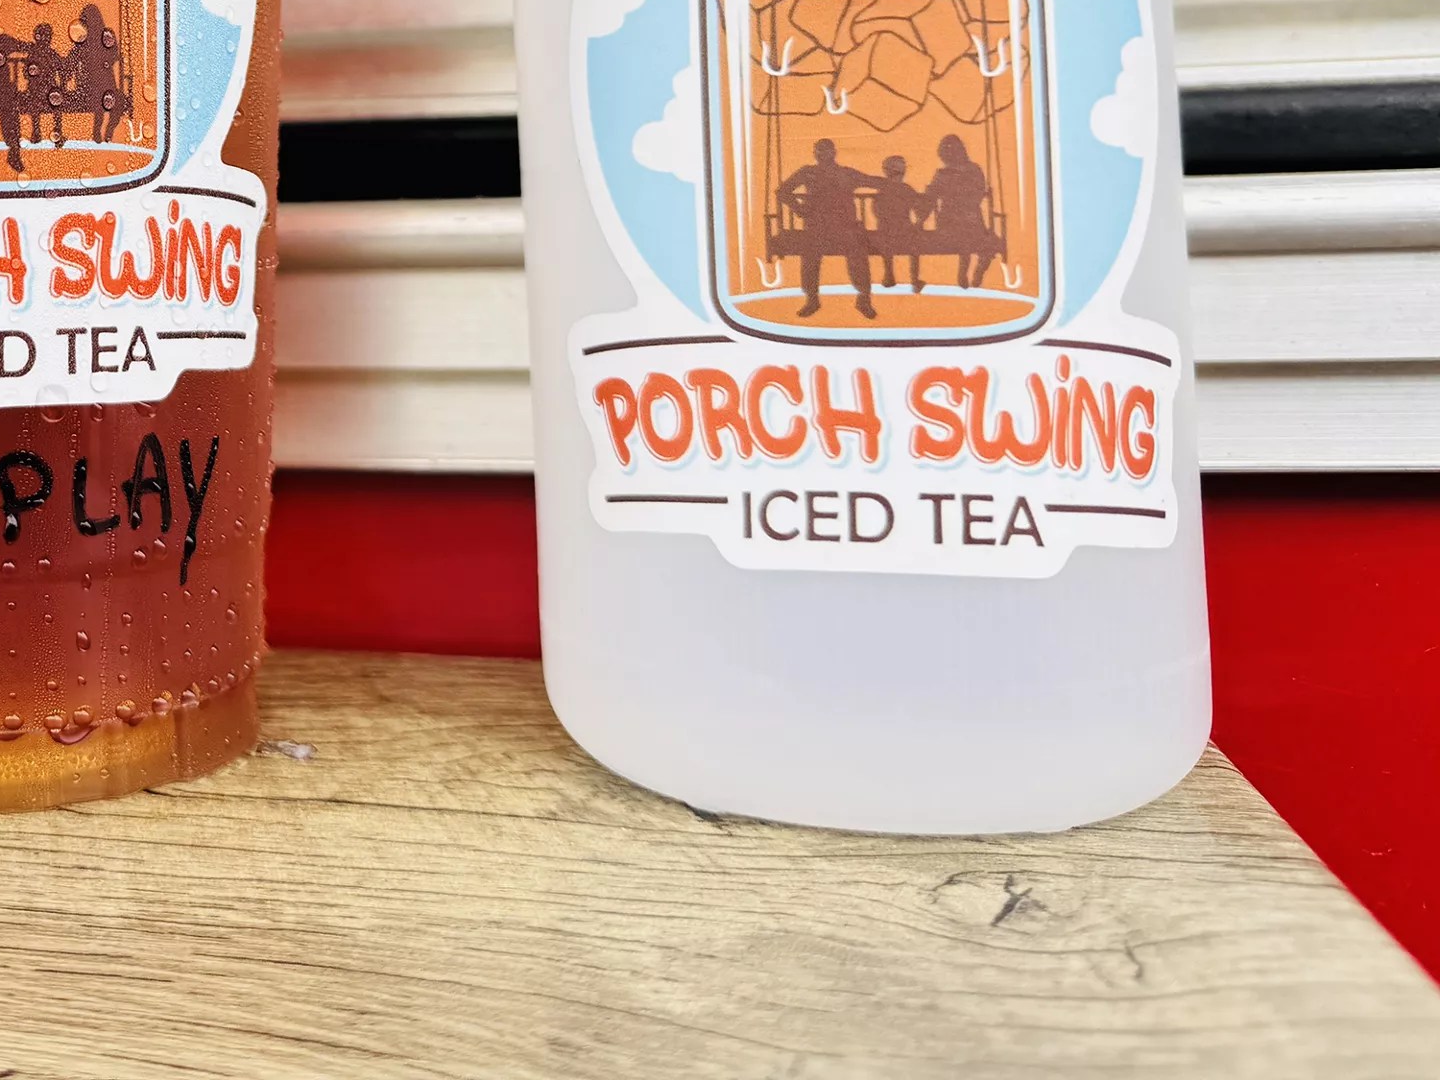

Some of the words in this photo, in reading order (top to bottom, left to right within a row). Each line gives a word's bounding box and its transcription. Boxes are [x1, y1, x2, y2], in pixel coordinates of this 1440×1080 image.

[56, 325, 158, 376] TEA
[592, 363, 884, 467] PORCH
[742, 489, 896, 545] ICED
[918, 491, 1046, 549] TEA
